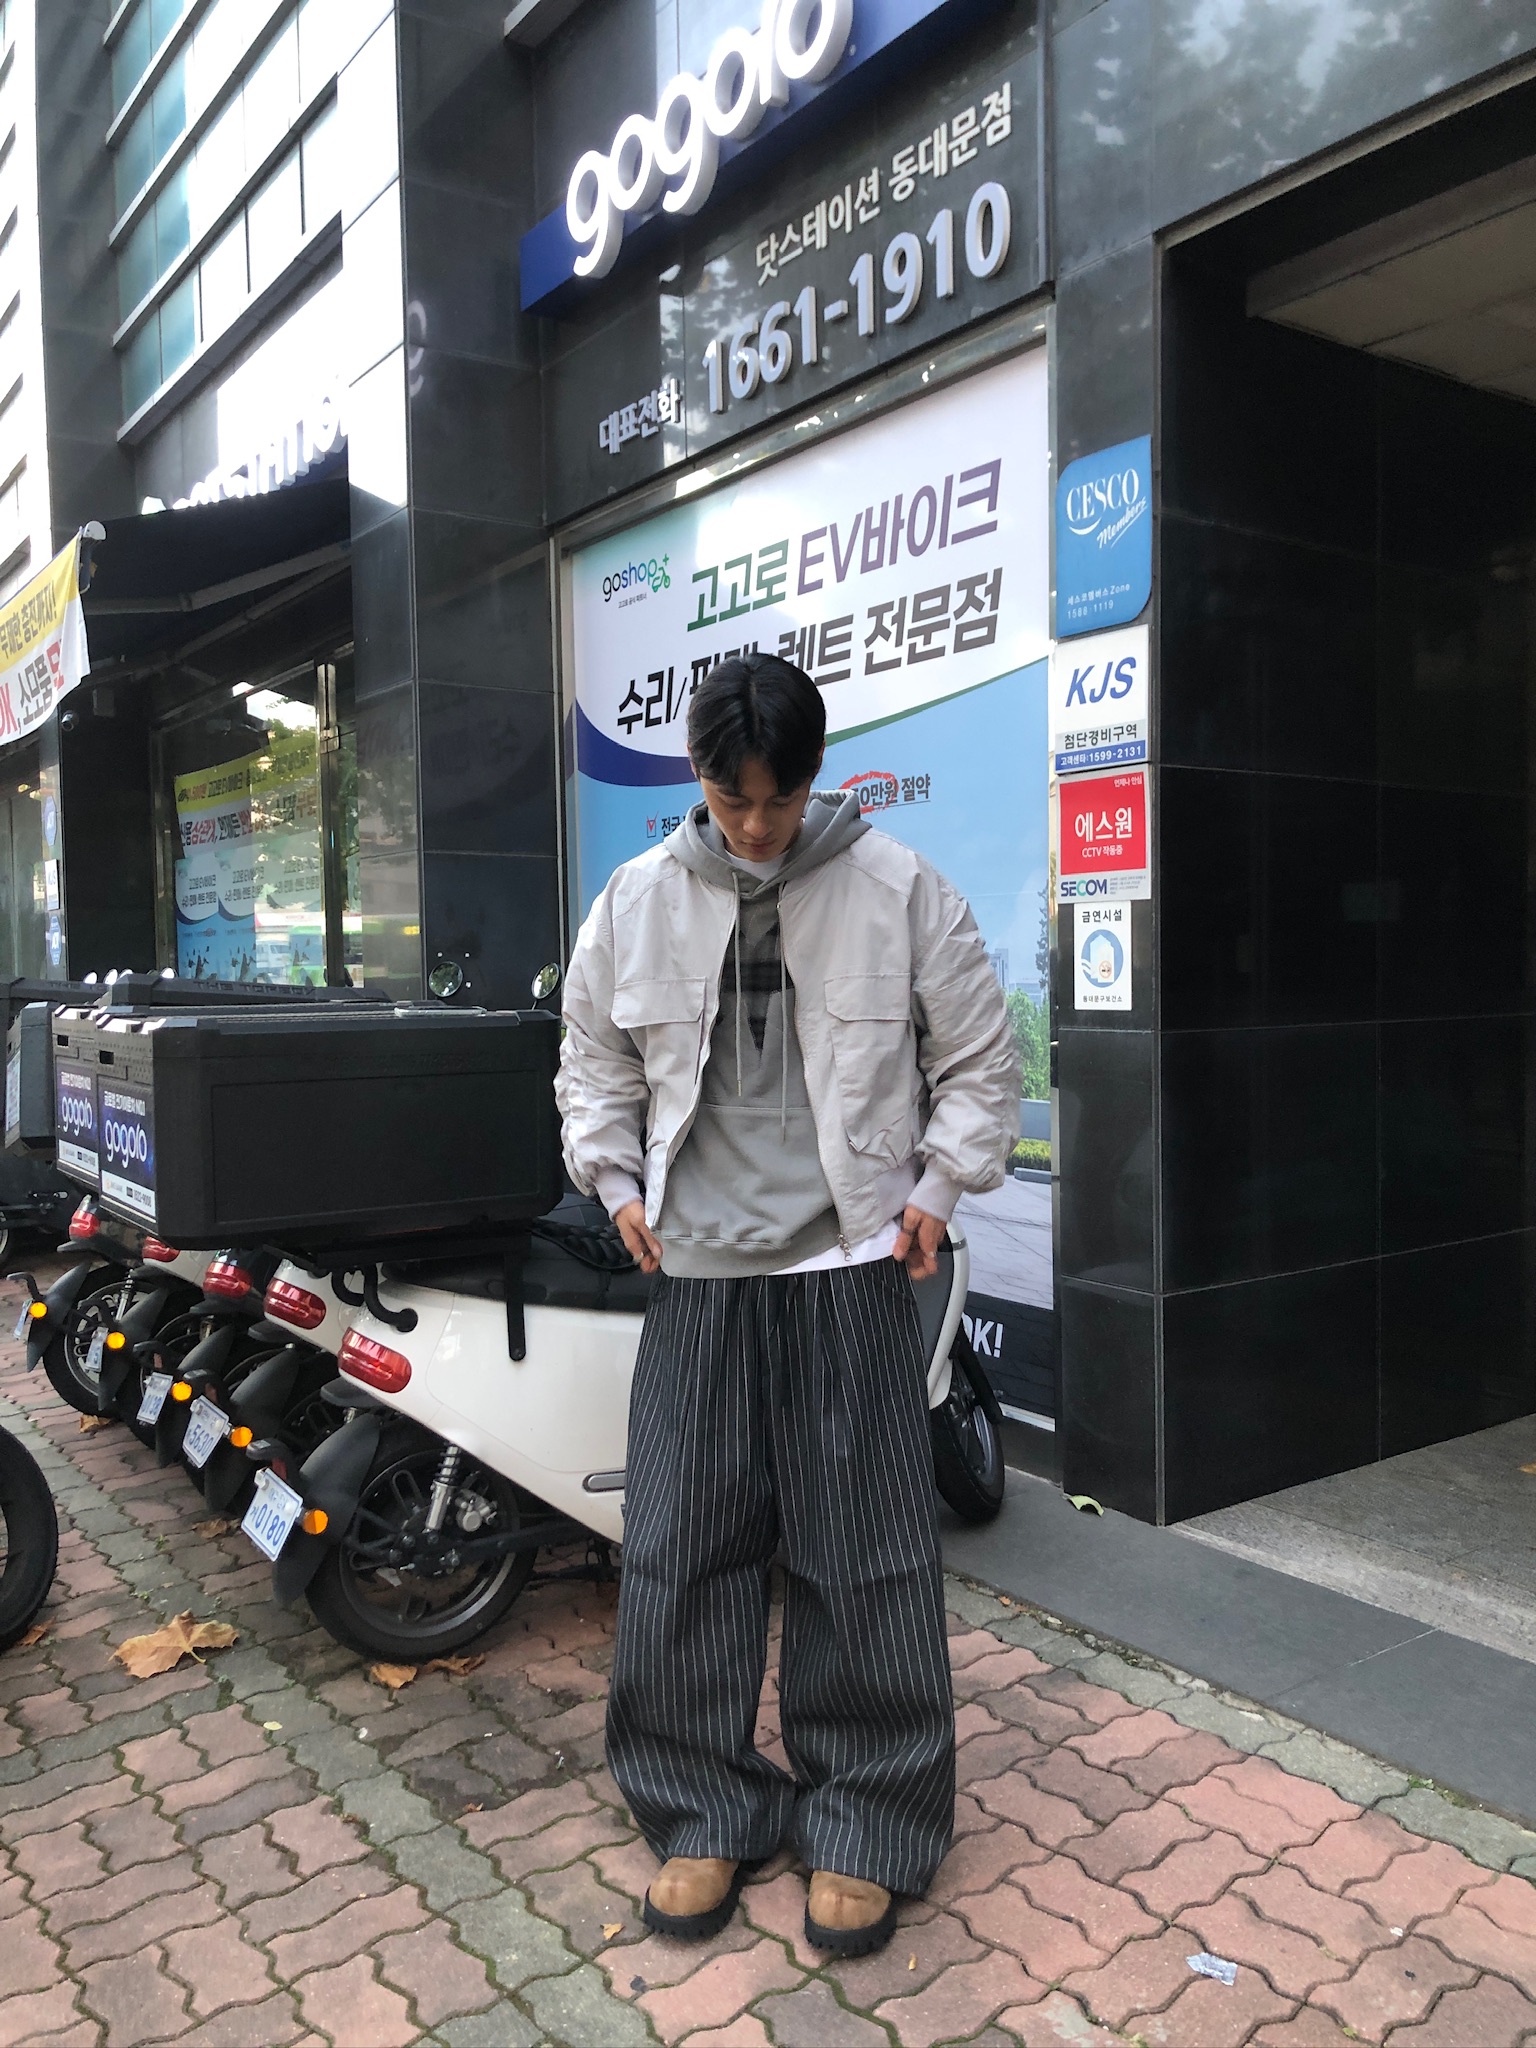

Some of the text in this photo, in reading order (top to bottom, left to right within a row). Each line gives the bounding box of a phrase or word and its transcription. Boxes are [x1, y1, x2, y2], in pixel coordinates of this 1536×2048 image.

[755, 80, 1013, 287] 닷스테이션 동대문점
[598, 181, 1012, 454] 대표전화 1661-1910
[1066, 468, 1140, 524] CESCO
[686, 457, 1003, 633] 고고로 EV바이크
[1096, 496, 1147, 549] Members
[863, 567, 1004, 677] 전문점
[1065, 656, 1137, 708] KJS
[1064, 723, 1138, 750] 첨단경비구역
[901, 773, 931, 802] 절약
[1074, 806, 1133, 843] 에스원
[1081, 843, 1123, 859] CCTV 작동중
[1060, 878, 1108, 897] SECOM
[1081, 908, 1123, 924] 금연시설
[1082, 994, 1123, 1004] 동대문구보건소
[255, 1502, 287, 1548] 0180
